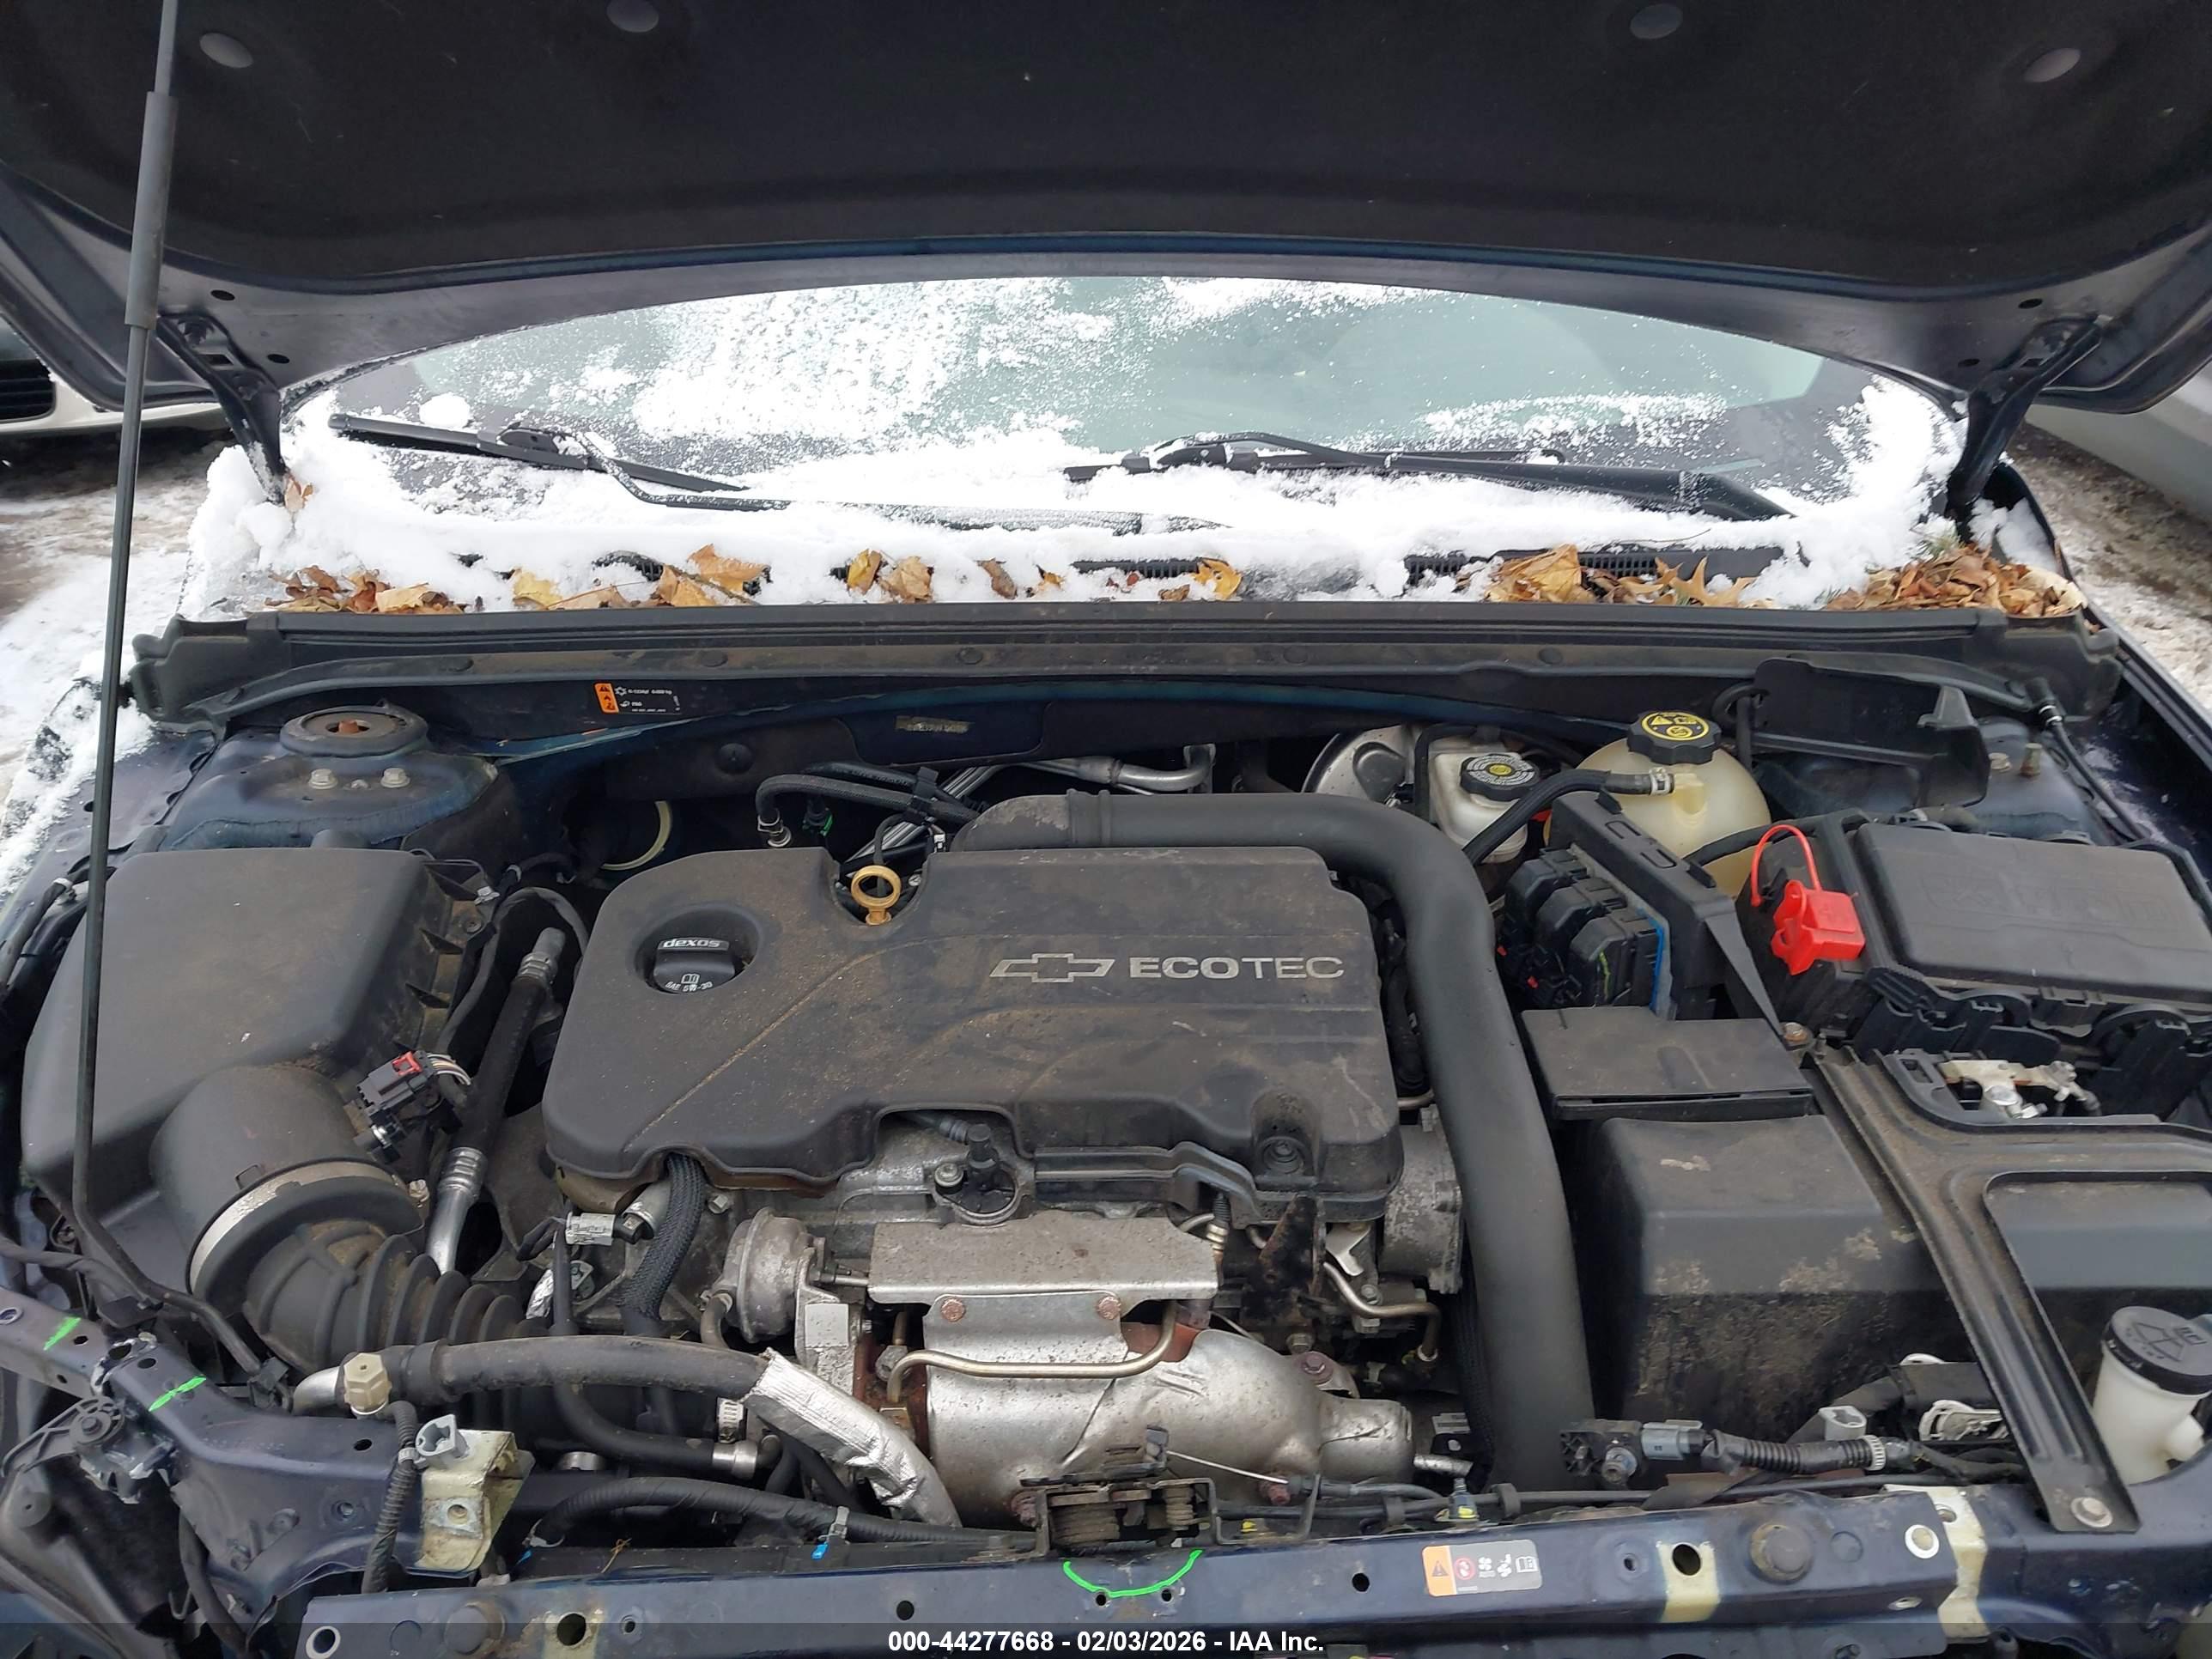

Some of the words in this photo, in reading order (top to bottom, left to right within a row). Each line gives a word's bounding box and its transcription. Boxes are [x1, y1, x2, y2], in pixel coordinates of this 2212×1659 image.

[663, 939, 720, 947] dexos
[1128, 957, 1345, 980] ECOTEC
[665, 981, 681, 990] SAE
[683, 981, 713, 992] 5W-30
